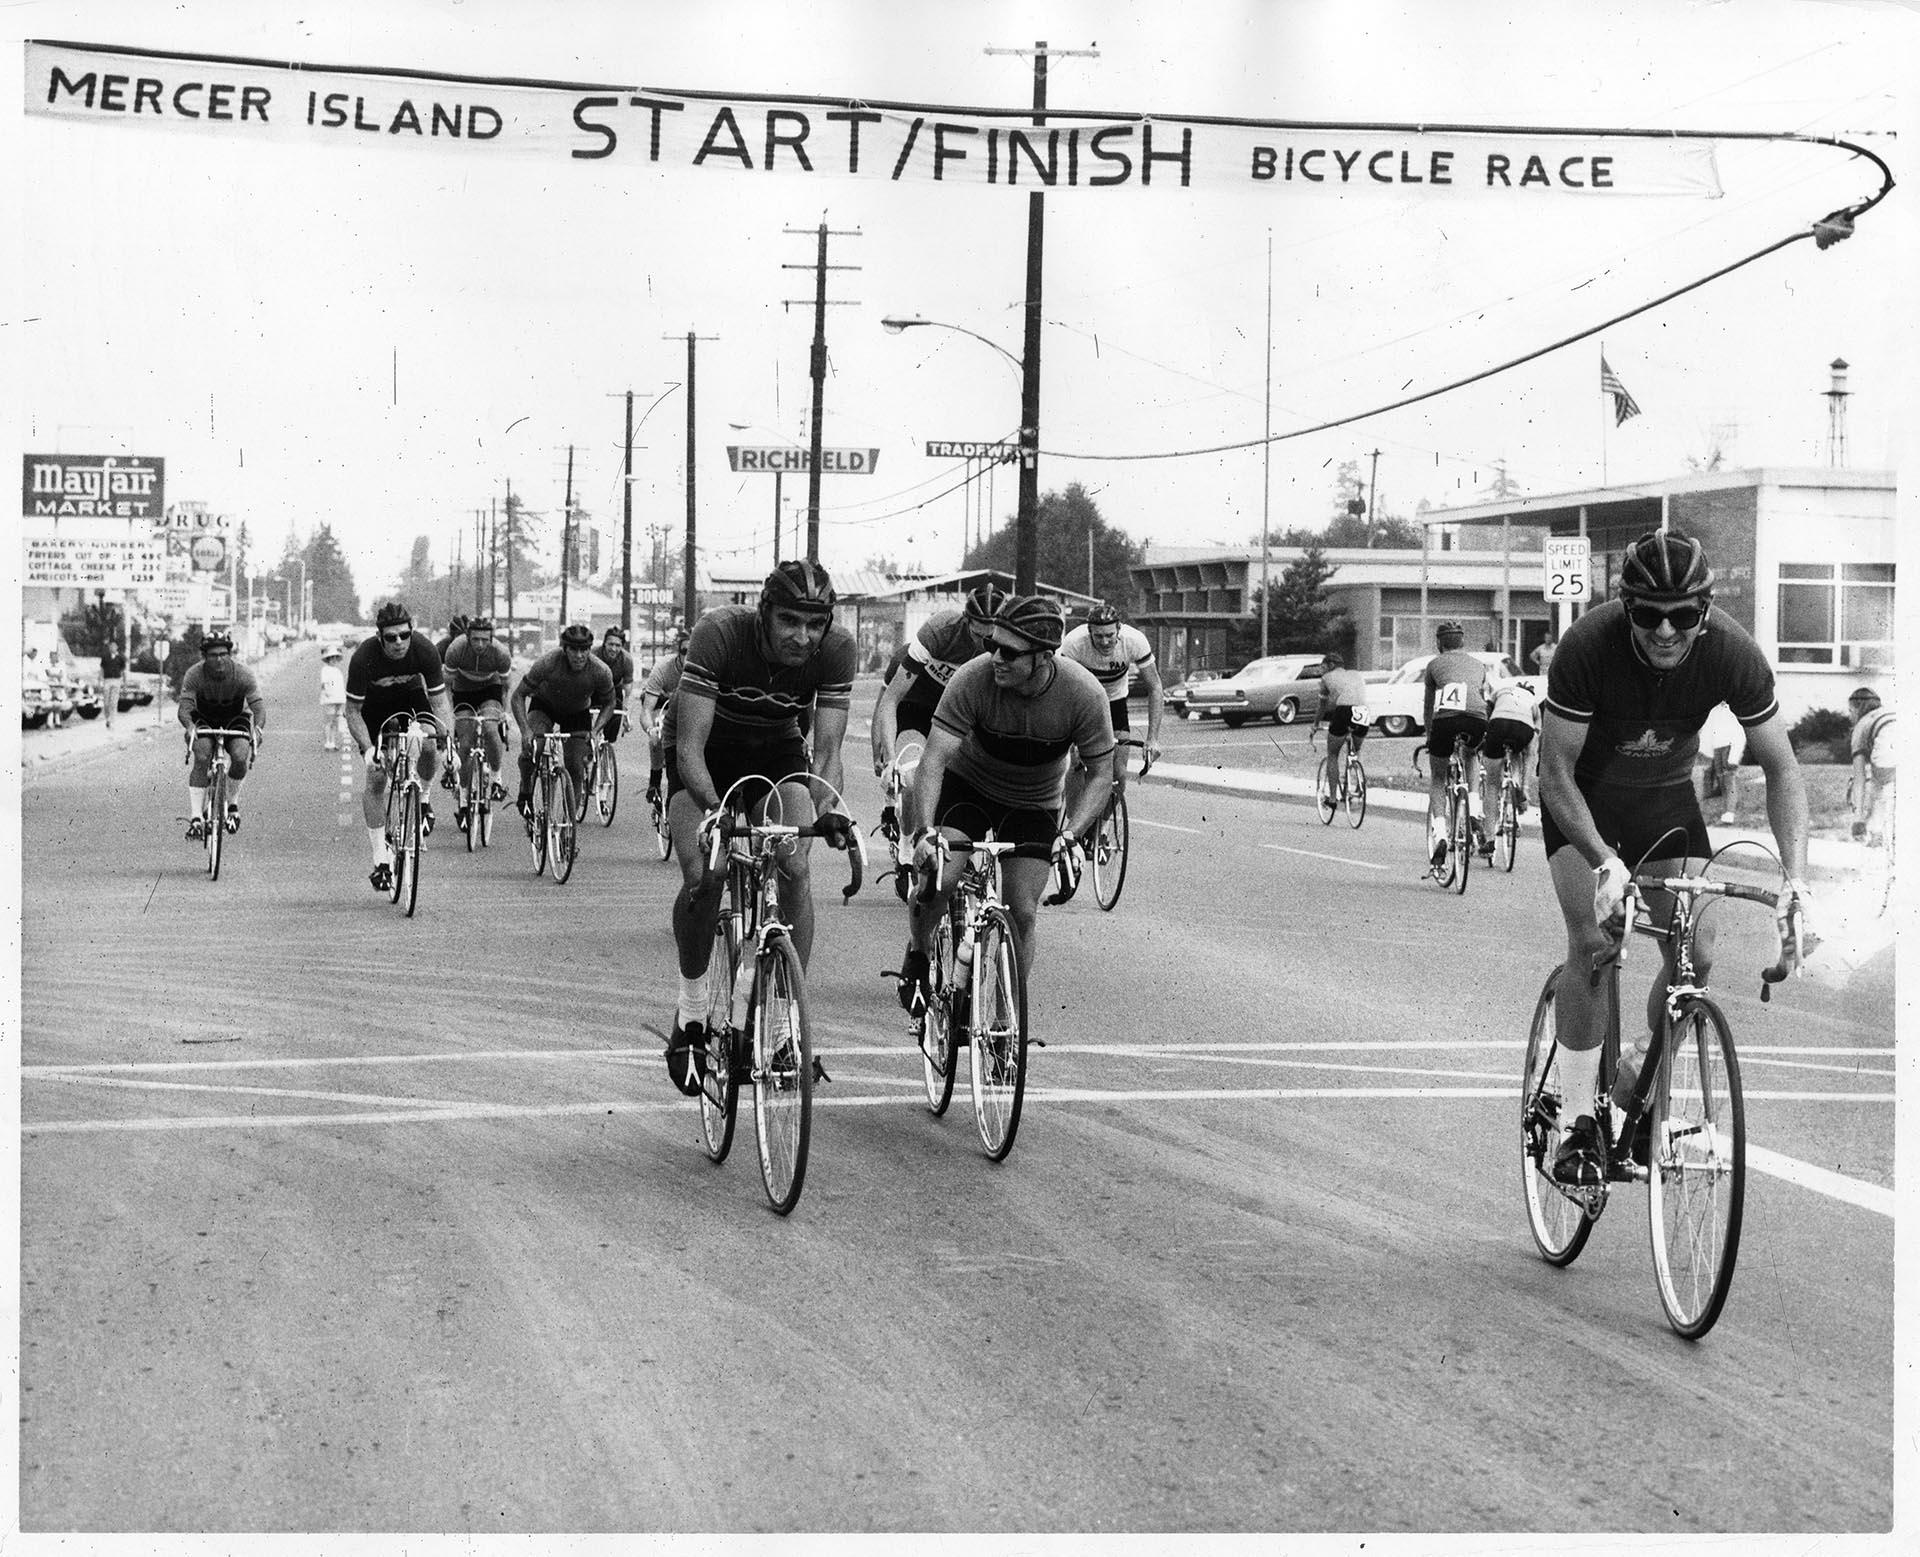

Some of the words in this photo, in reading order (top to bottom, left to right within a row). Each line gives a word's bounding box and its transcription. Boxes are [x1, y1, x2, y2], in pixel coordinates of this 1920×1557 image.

[47, 67, 272, 122] MERCER
[307, 91, 503, 139] ISLAND
[571, 97, 1192, 187] START/FINISH
[1251, 146, 1454, 184] BICYCLE
[1486, 154, 1613, 188] RACE
[929, 442, 1020, 457] TRADEWE
[742, 450, 864, 470] RICHFELD
[35, 501, 150, 516] MARKET
[155, 514, 229, 528] DRUG
[75, 552, 91, 560] CUT
[1548, 544, 1586, 556] SPEED
[28, 561, 72, 570] COTTAGE
[80, 562, 115, 571] CHEESE
[1551, 559, 1582, 570] LIMIT
[28, 573, 77, 581] APRICOTS
[1551, 574, 1584, 595] 25
